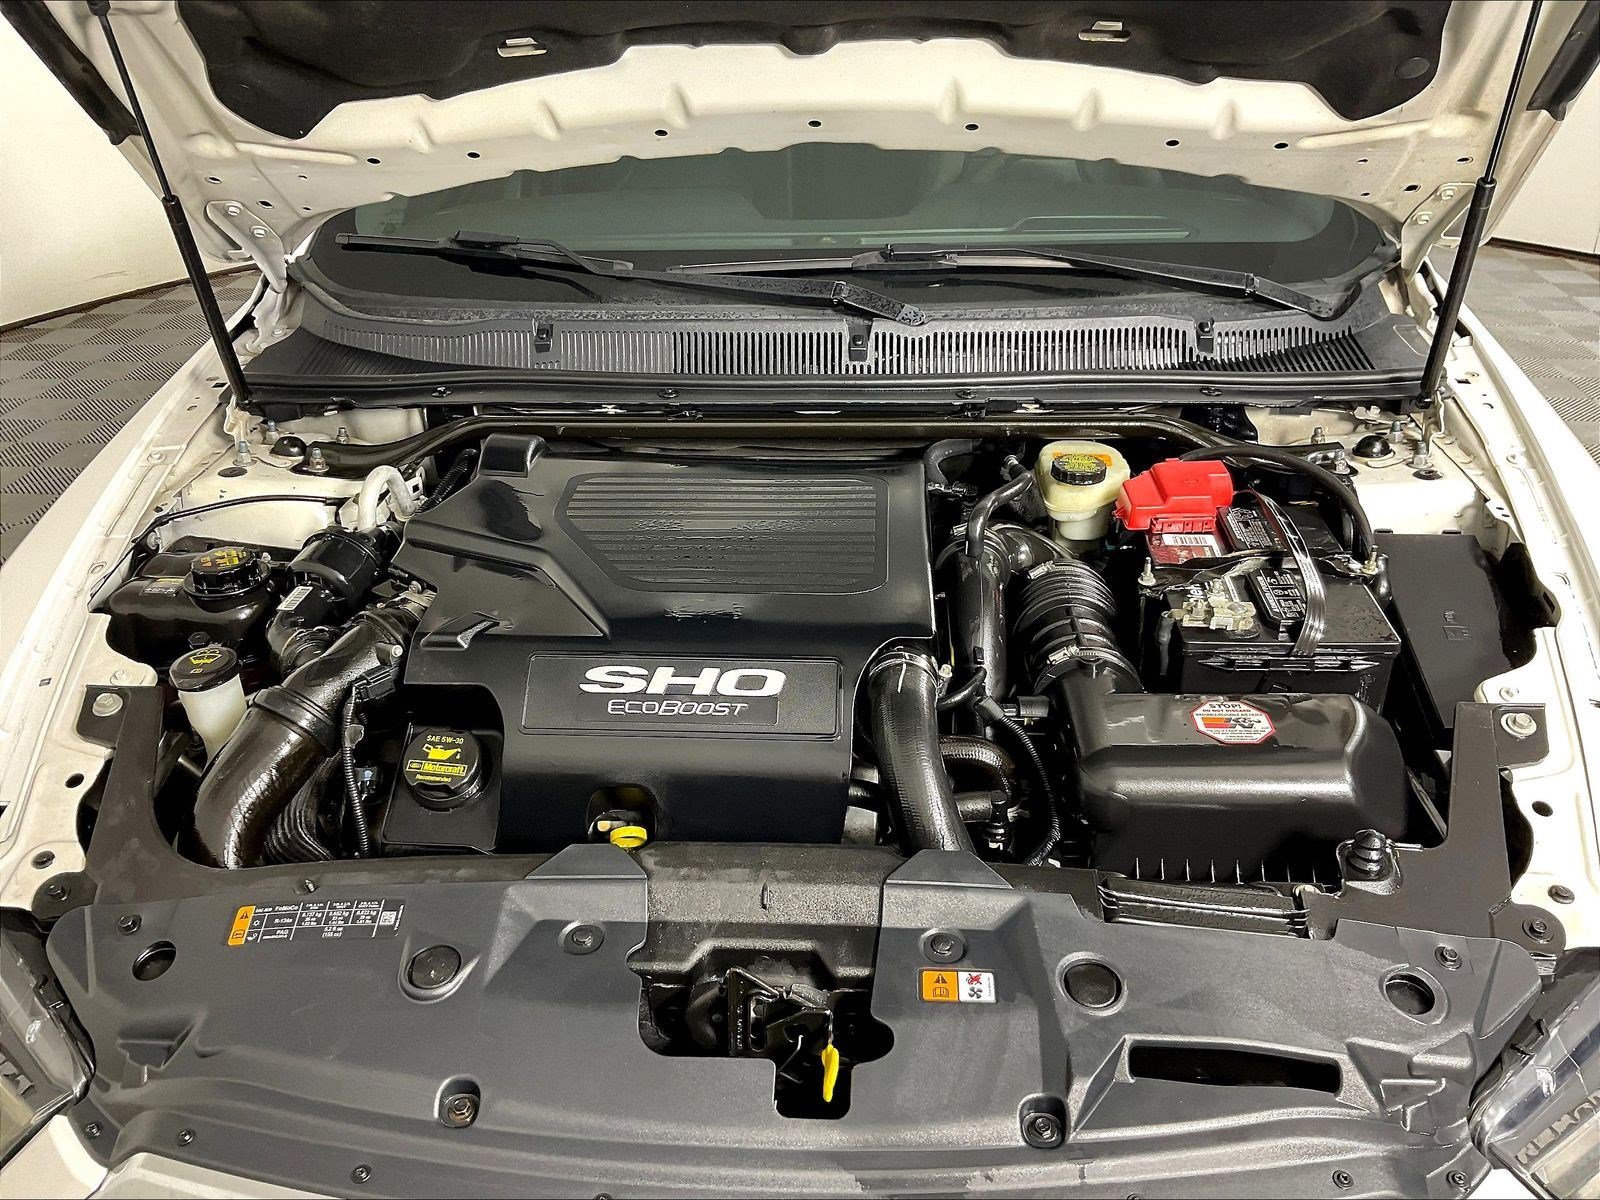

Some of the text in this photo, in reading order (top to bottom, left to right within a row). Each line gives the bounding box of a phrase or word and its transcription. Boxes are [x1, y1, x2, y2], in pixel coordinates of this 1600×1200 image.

[578, 665, 787, 697] SHO
[607, 699, 748, 717] ECOBOOST
[426, 734, 465, 744] SAE 5W-30
[423, 763, 465, 775] Motorcraft
[415, 774, 452, 782] Recommended
